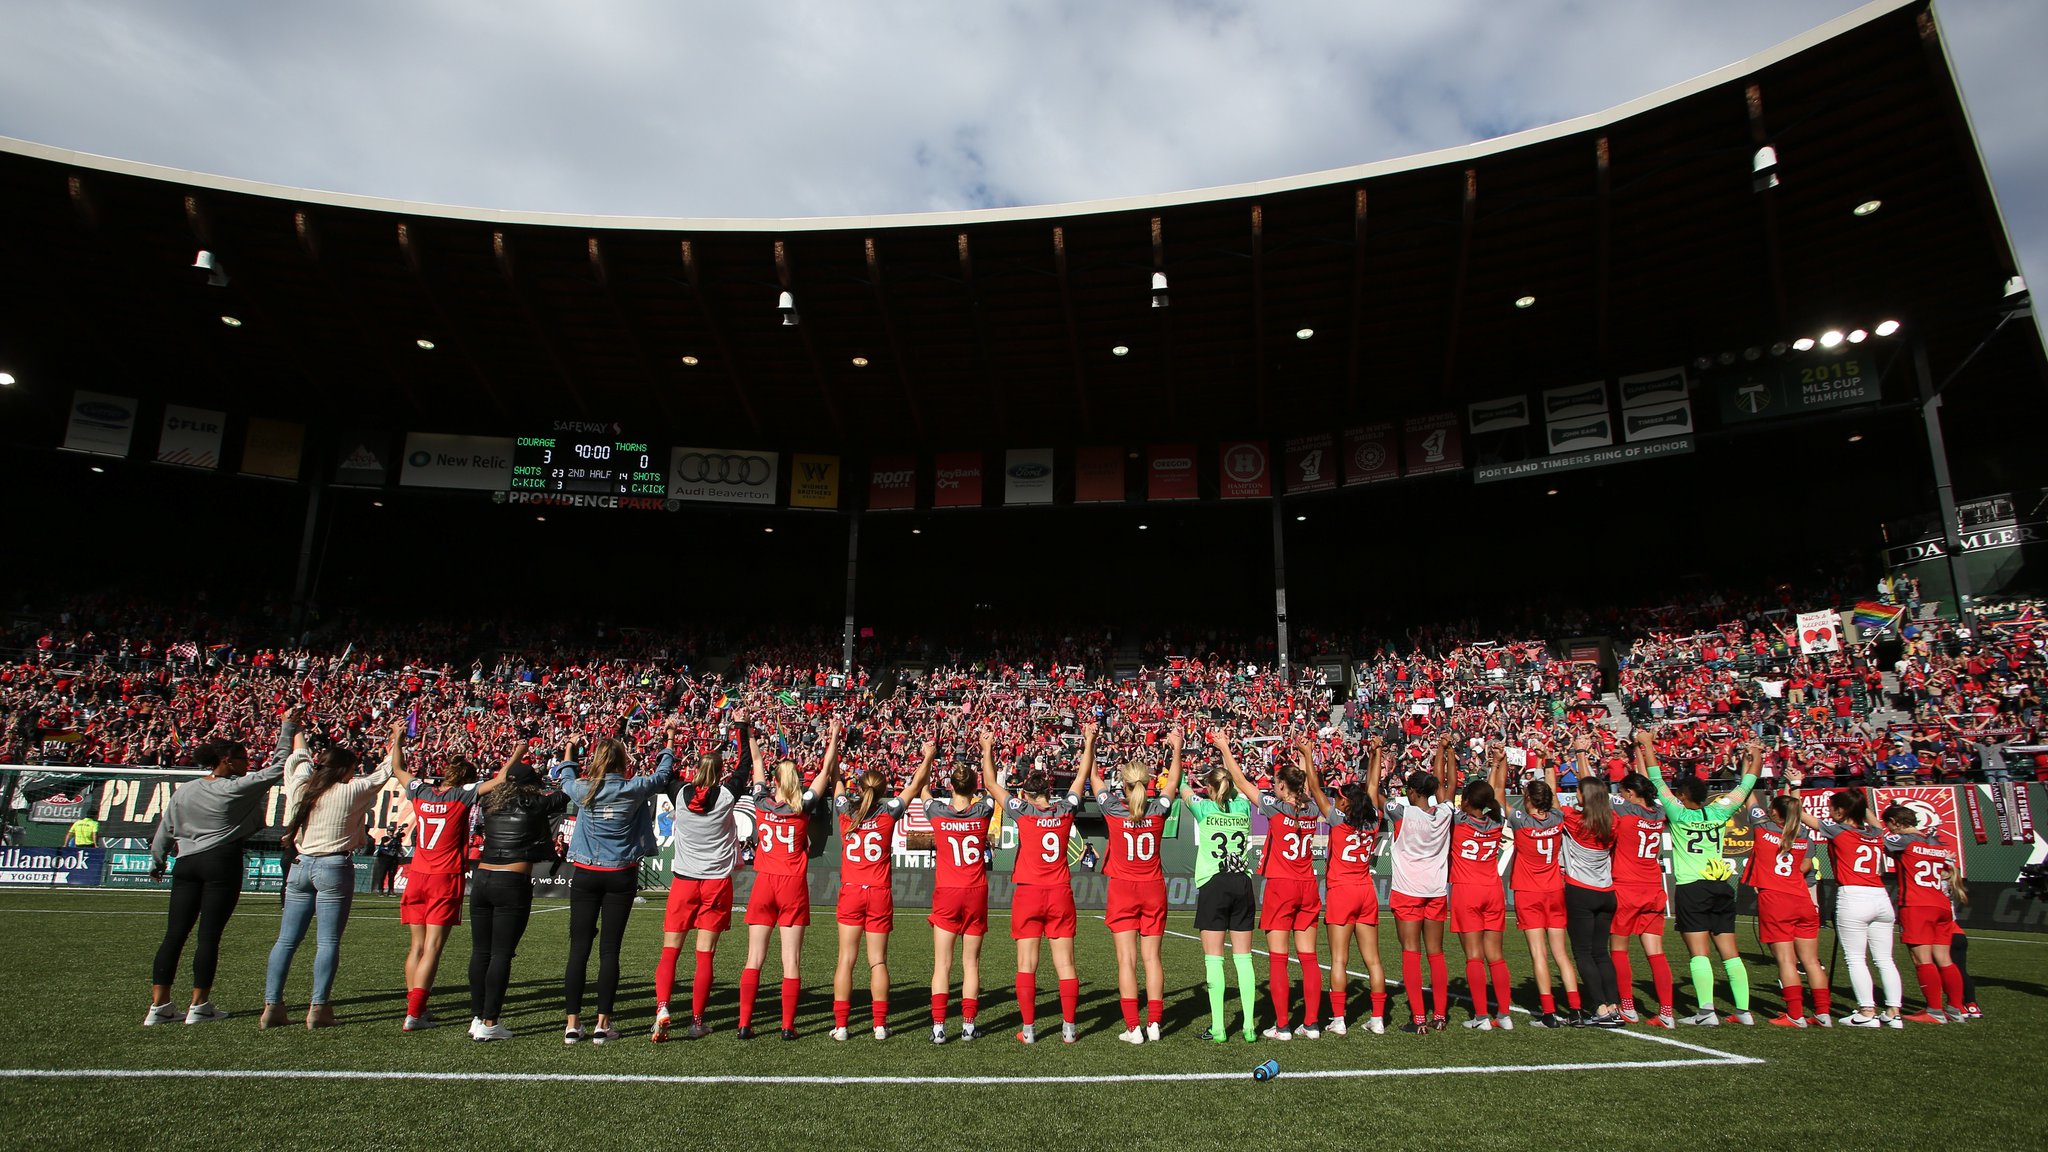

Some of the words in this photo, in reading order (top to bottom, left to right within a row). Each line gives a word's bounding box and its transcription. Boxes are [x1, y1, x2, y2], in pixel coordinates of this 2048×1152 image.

[1800, 360, 1860, 384] 2015
[1802, 381, 1830, 395] MLS
[1833, 376, 1862, 390] CUP
[1803, 387, 1865, 405] CHAMPIONS
[181, 420, 217, 433] FLIR
[553, 420, 609, 434] SAFEWAY
[517, 437, 557, 448] COURAGE
[615, 442, 648, 452] THORNS
[437, 453, 467, 467] New
[543, 449, 552, 465] 3
[574, 444, 611, 460] 90:00
[1479, 463, 1538, 479] PORTLAND
[1541, 455, 1590, 470] TIMBERS
[1593, 449, 1622, 462] RING
[1624, 447, 1641, 458] OF
[1643, 440, 1688, 454] HONOR
[640, 454, 649, 469] 0
[1155, 459, 1189, 469] OREGON
[513, 465, 542, 476] SHOTS
[551, 468, 564, 478] 23
[567, 469, 585, 478] 2ND
[590, 469, 613, 479] HALF
[619, 472, 628, 481] 14
[632, 471, 661, 482] SHOTS
[872, 470, 914, 484] ROOT
[936, 468, 981, 480] KeyBank
[1014, 466, 1042, 478] Ford
[512, 477, 546, 489] C.KICK
[557, 480, 563, 490] 3
[631, 484, 666, 494] C.KICK
[508, 491, 618, 509] PROVIDENCE
[620, 496, 666, 511] PARK
[675, 487, 705, 497] Audi
[708, 489, 770, 501] Beaverton
[1905, 528, 2041, 560] DAMLER
[2016, 785, 2027, 799] GET
[98, 779, 173, 823] PLA
[420, 803, 446, 813] HEATH
[1800, 795, 1829, 807] ATH
[36, 805, 81, 818] TOUGH
[2018, 799, 2031, 821] STUCK
[941, 820, 981, 831] SONNETT
[1123, 818, 1152, 829] HORAN
[418, 815, 446, 850] 17
[759, 823, 795, 854] 34
[845, 832, 882, 863] 26
[1041, 832, 1060, 863] 9
[1123, 832, 1155, 861] 10
[1211, 831, 1247, 859] 33
[1341, 833, 1373, 863] 23
[1638, 830, 1661, 859] 12
[1687, 828, 1720, 854] 24
[947, 835, 980, 866] 16
[1461, 839, 1497, 862] 27
[1536, 838, 1553, 864] 4
[115, 854, 174, 872] Amia
[1774, 852, 1794, 877] 8
[1853, 844, 1881, 875] 21
[11, 872, 56, 881] YOGURT
[554, 876, 567, 885] do
[1914, 860, 1944, 890] 25
